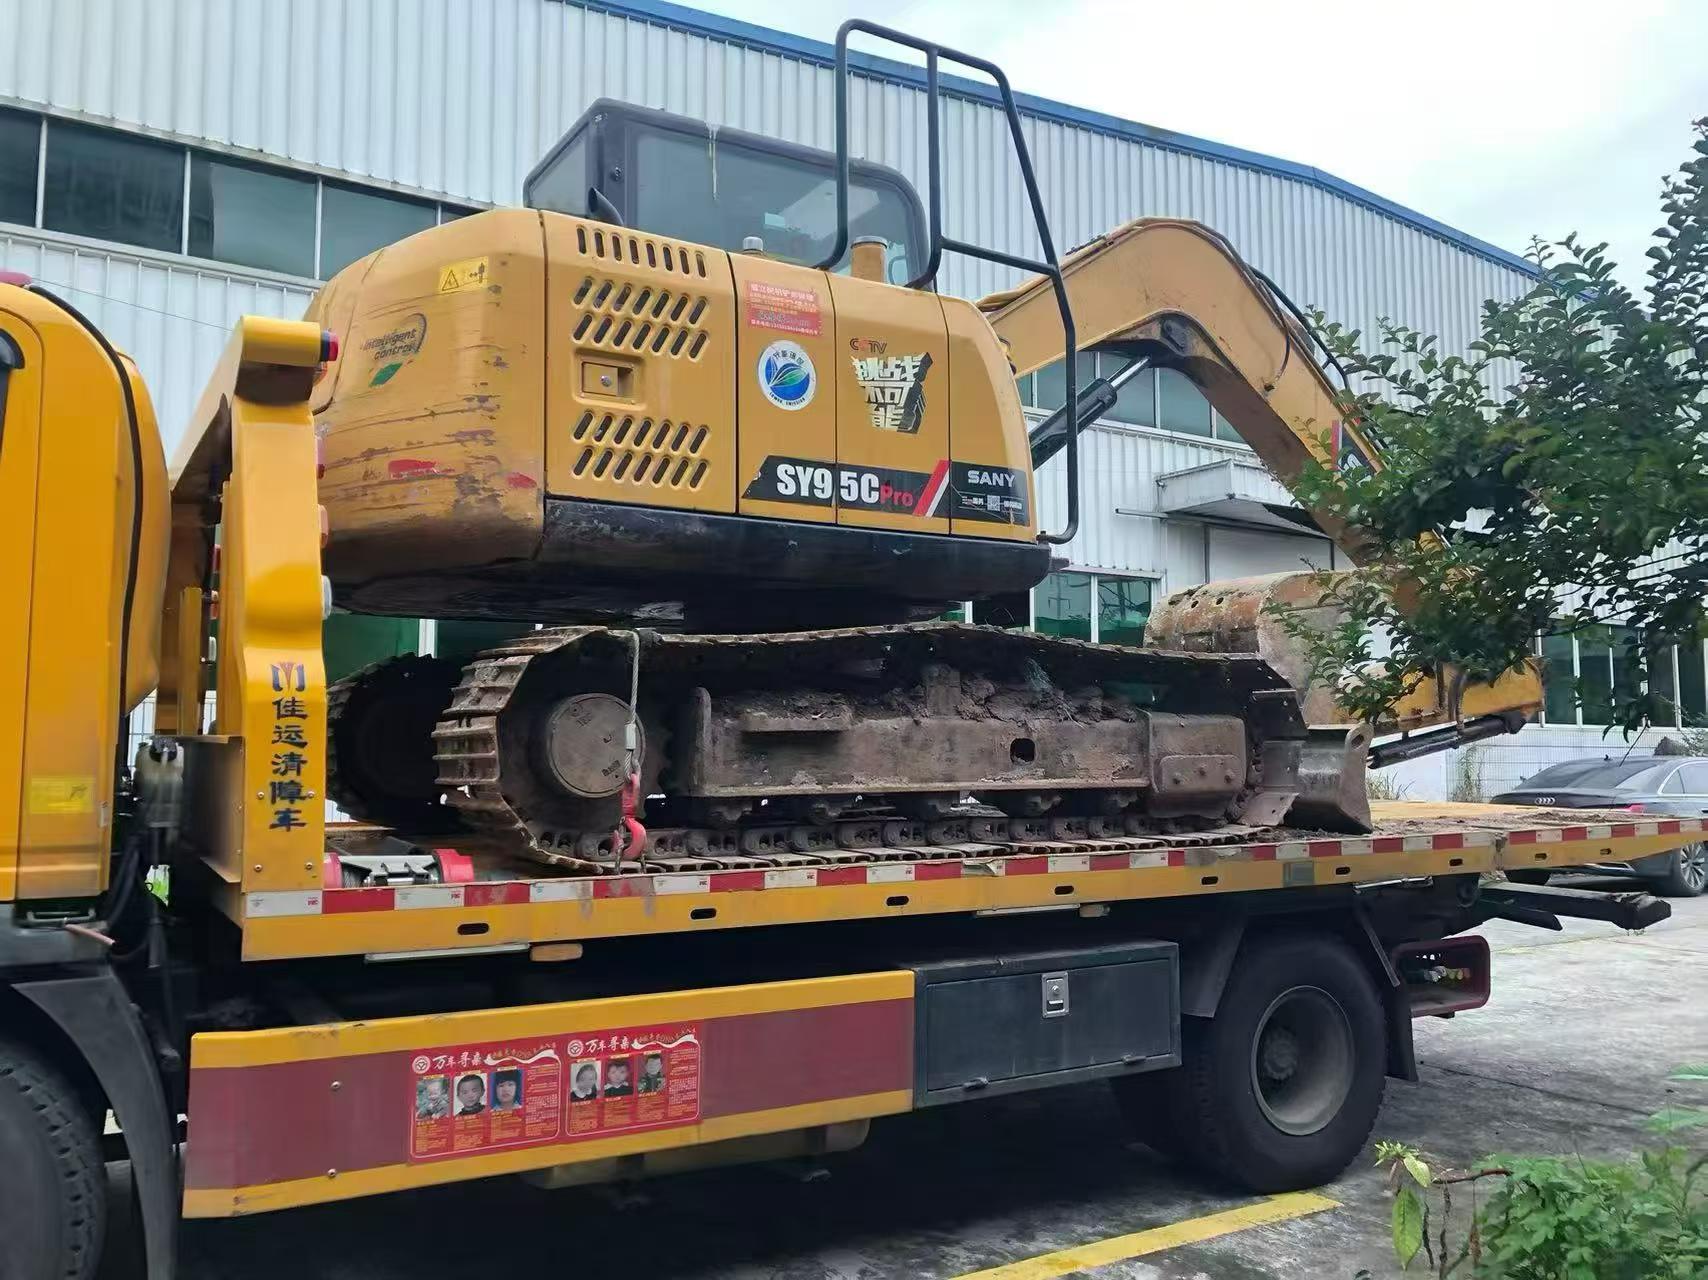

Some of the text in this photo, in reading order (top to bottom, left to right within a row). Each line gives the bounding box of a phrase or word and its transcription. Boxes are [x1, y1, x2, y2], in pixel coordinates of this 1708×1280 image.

[967, 469, 1015, 488] SANY
[880, 484, 914, 507] Pro
[269, 696, 309, 832] 佳运清障车
